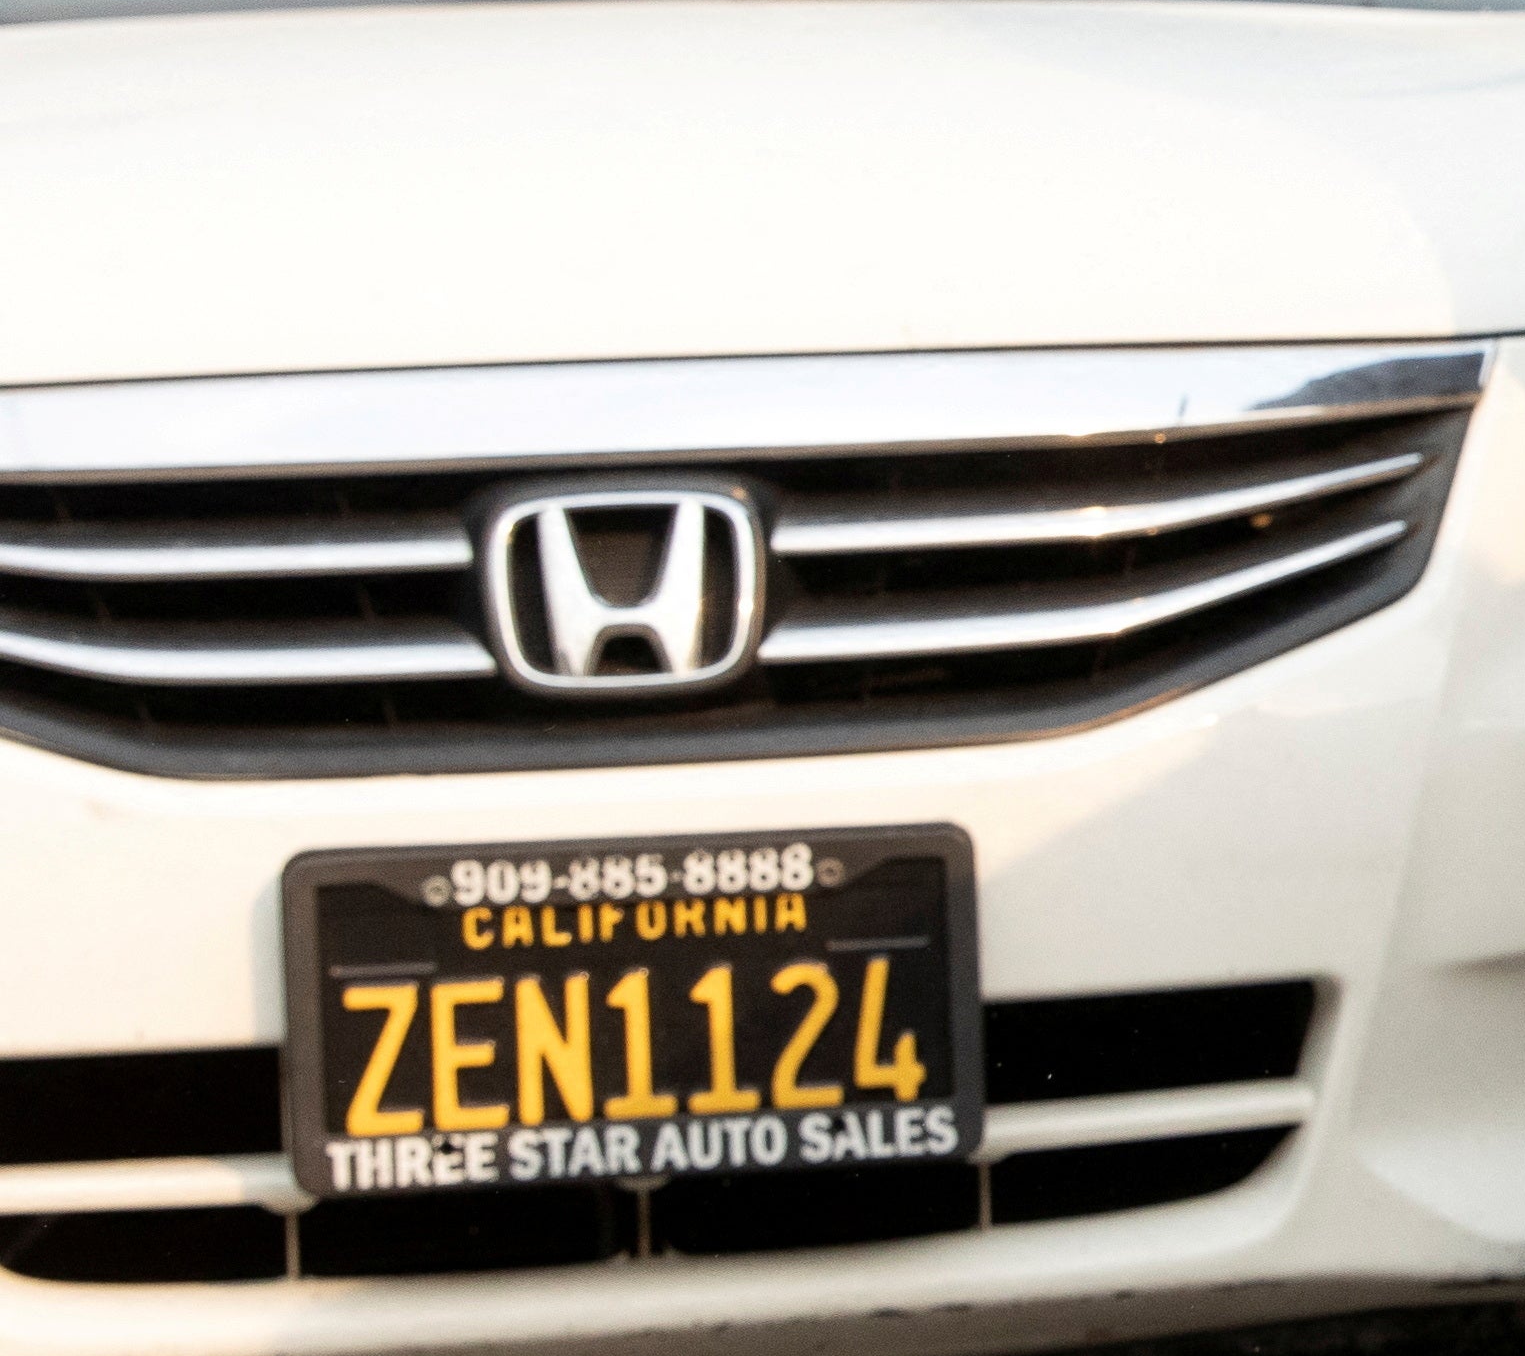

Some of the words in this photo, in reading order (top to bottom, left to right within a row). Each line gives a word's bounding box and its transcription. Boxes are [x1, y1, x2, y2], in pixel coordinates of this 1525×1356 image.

[450, 842, 815, 908] 909-885-8888
[461, 892, 808, 951] CALIFORNIA
[341, 956, 928, 1137] ZEN1124
[326, 1132, 501, 1192] THREE
[507, 1122, 642, 1182] STAR
[650, 1113, 788, 1173] AUTO
[798, 1104, 961, 1165] SALES
